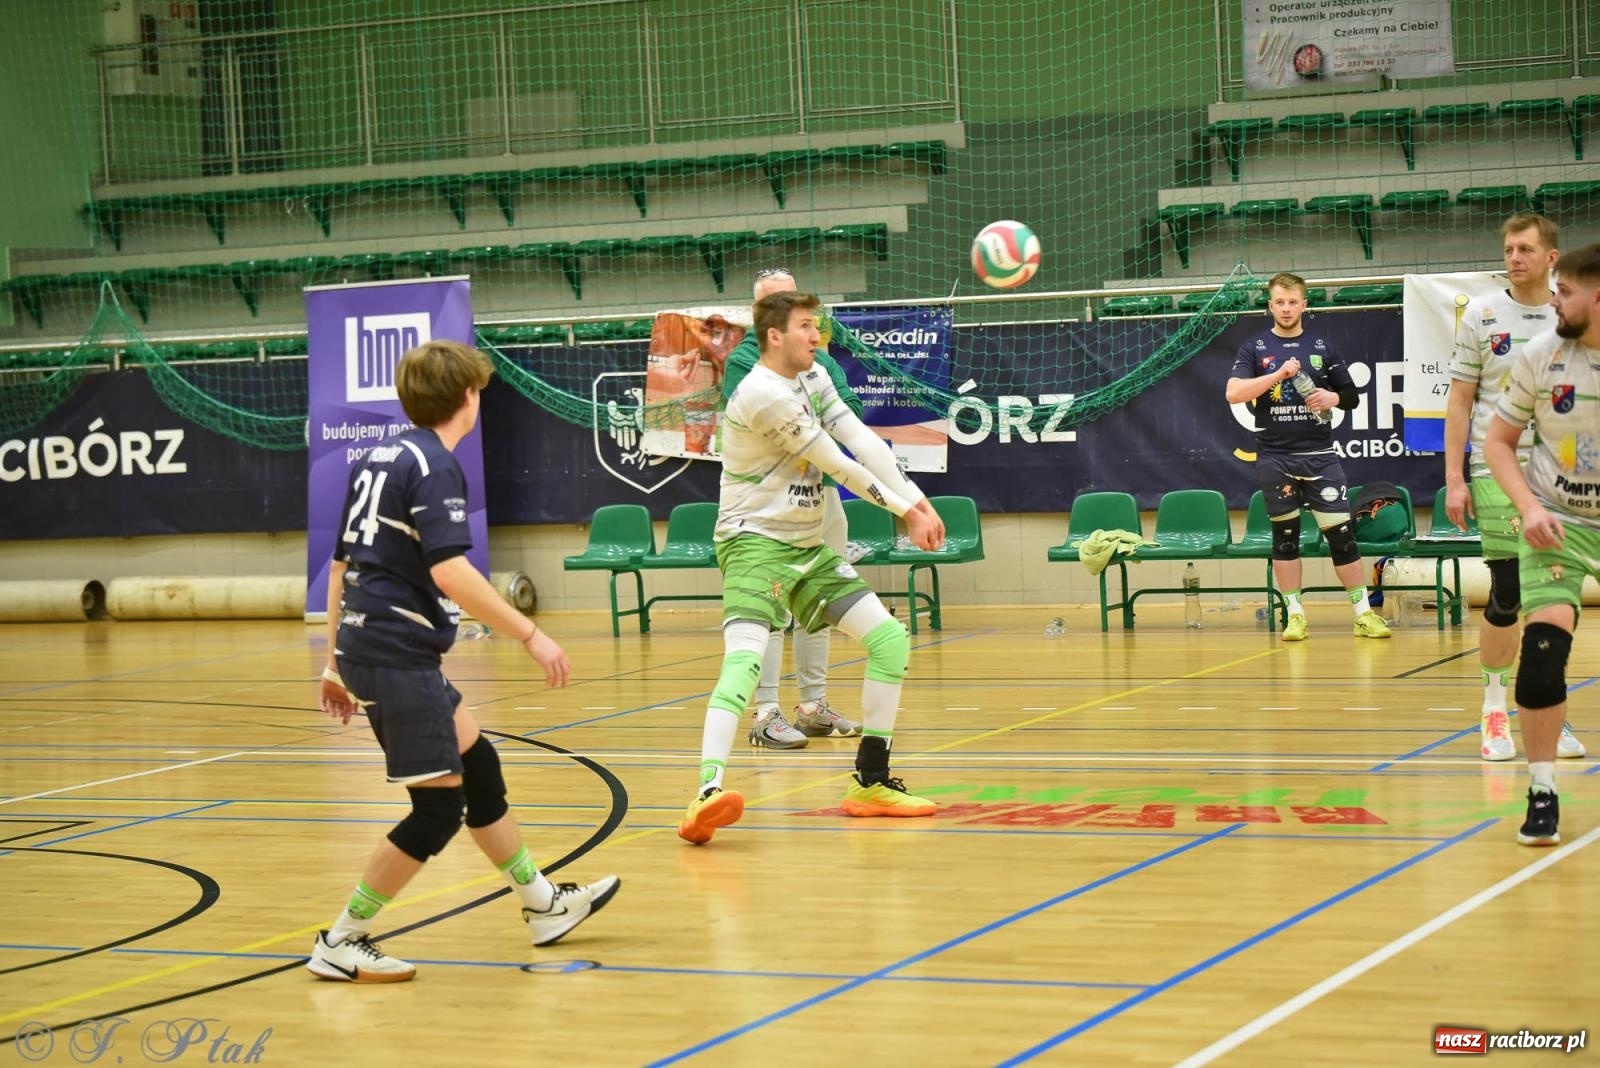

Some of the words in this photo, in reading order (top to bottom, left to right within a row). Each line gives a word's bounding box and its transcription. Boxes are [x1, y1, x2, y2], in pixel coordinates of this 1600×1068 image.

[1269, 0, 1316, 12] Operator
[1270, 12, 1326, 24] Pracownik
[1329, 6, 1393, 20] produkcyjny
[1334, 26, 1380, 37] Czekamy
[1383, 24, 1397, 33] na
[1400, 21, 1439, 32] Ciebie!
[1421, 361, 1444, 375] tel.
[1270, 405, 1297, 415] POMPY
[322, 422, 386, 443] budujemy
[0, 417, 188, 482] CIBÓRZ
[1341, 486, 1348, 501] 2
[1567, 498, 1592, 508] 605
